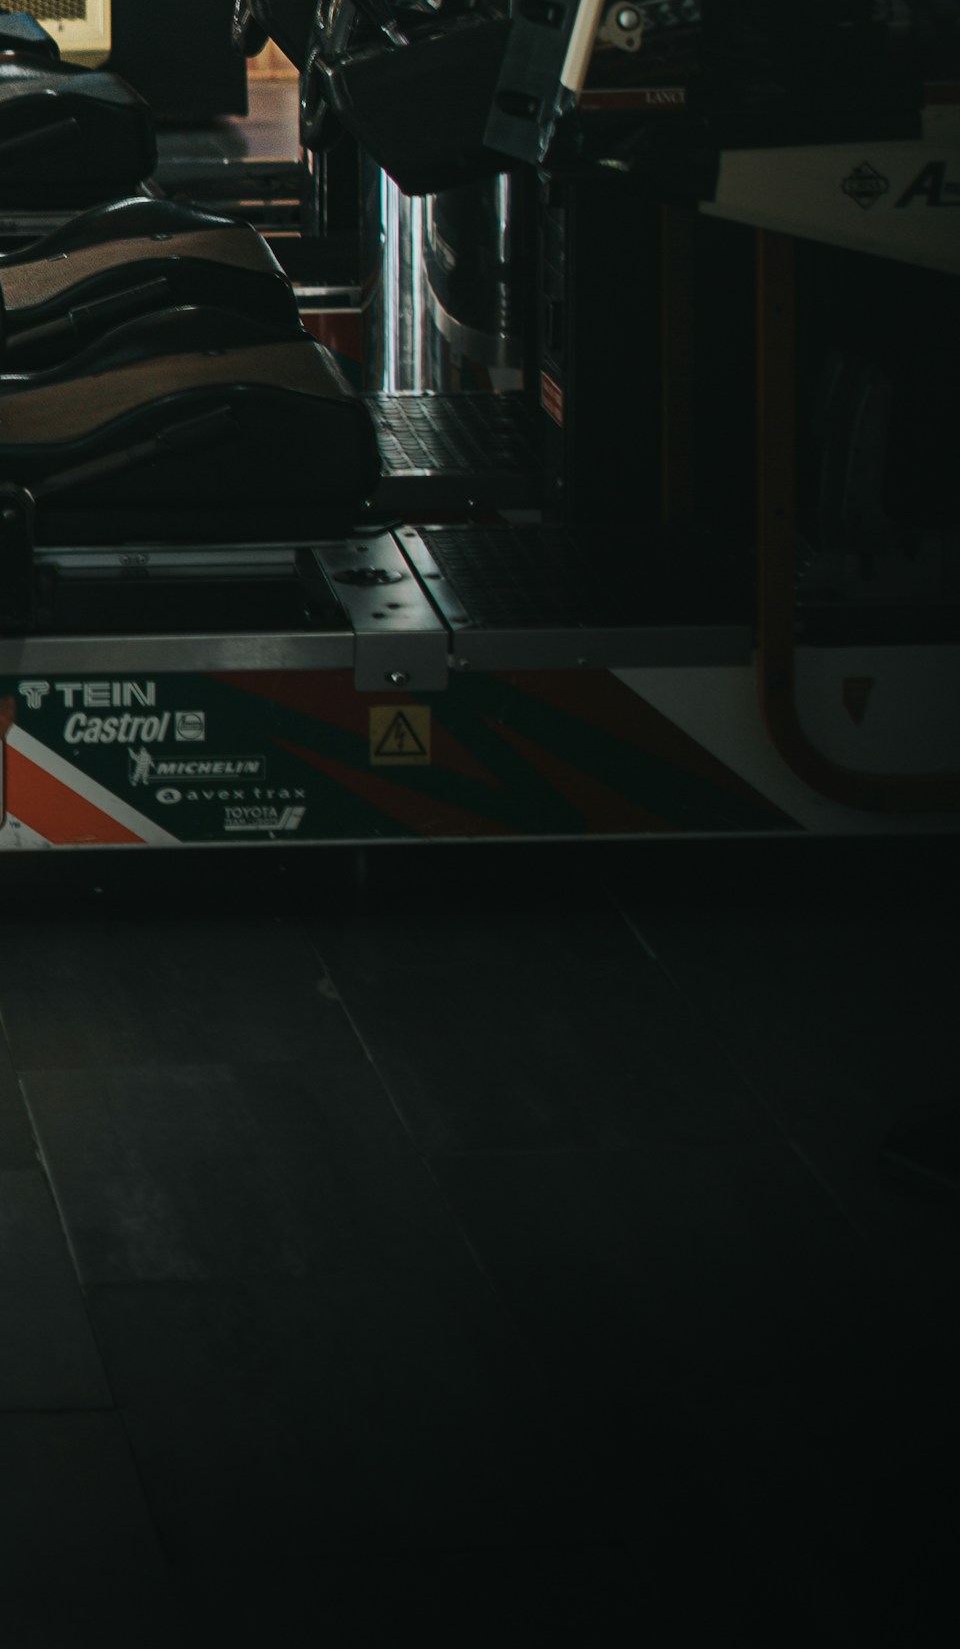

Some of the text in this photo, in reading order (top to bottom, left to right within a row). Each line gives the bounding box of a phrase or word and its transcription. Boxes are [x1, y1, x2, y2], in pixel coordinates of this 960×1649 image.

[55, 681, 156, 708] TEIN
[63, 711, 172, 745] Castrol
[154, 761, 261, 776] MICHELIN
[186, 789, 244, 801] avex
[254, 786, 307, 800] trax
[224, 806, 279, 819] TOYOTA
